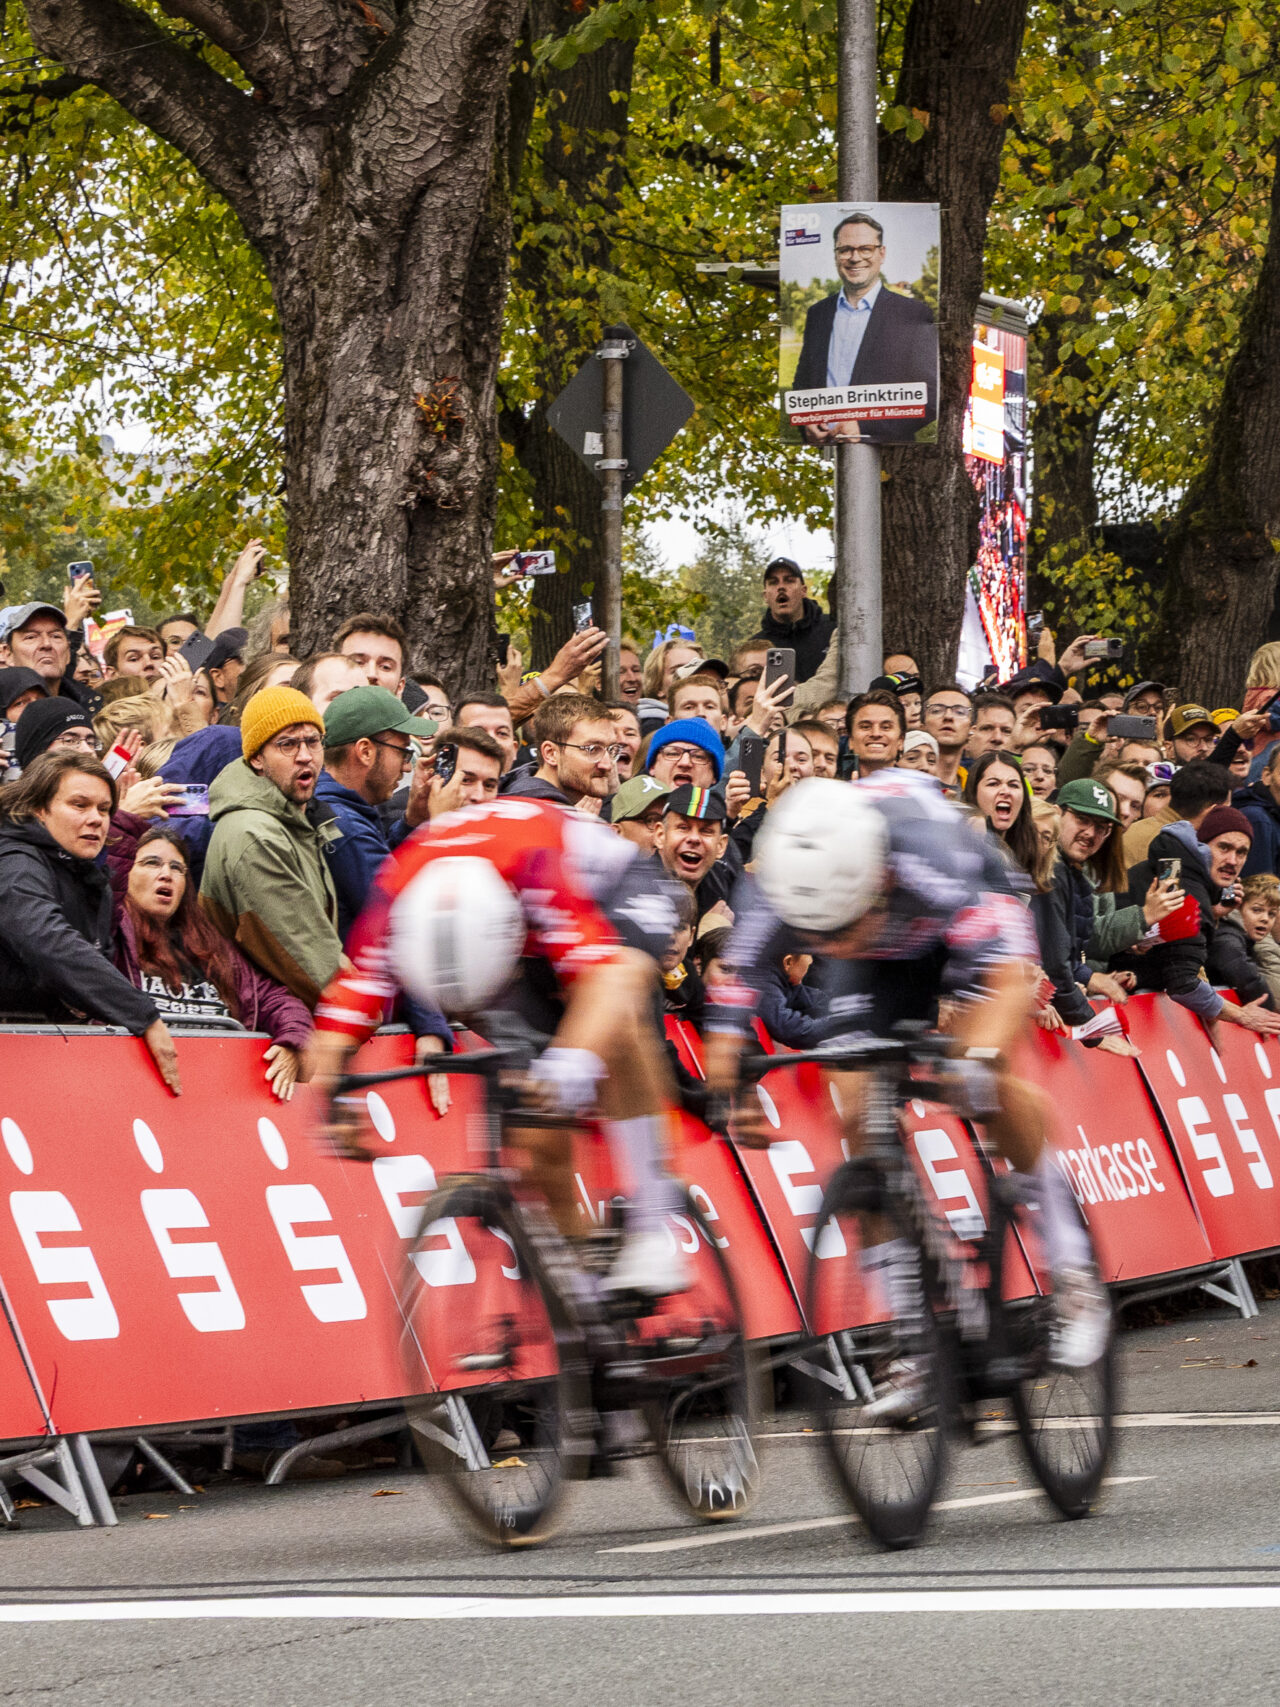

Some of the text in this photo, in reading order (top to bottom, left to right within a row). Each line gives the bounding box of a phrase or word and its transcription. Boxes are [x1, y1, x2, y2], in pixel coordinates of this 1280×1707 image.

[786, 212, 821, 229] SPD
[788, 388, 924, 410] Stephan Brinktrine
[790, 407, 924, 424] Oberbürgermeister für Münster
[1056, 1125, 1166, 1226] parkasse
